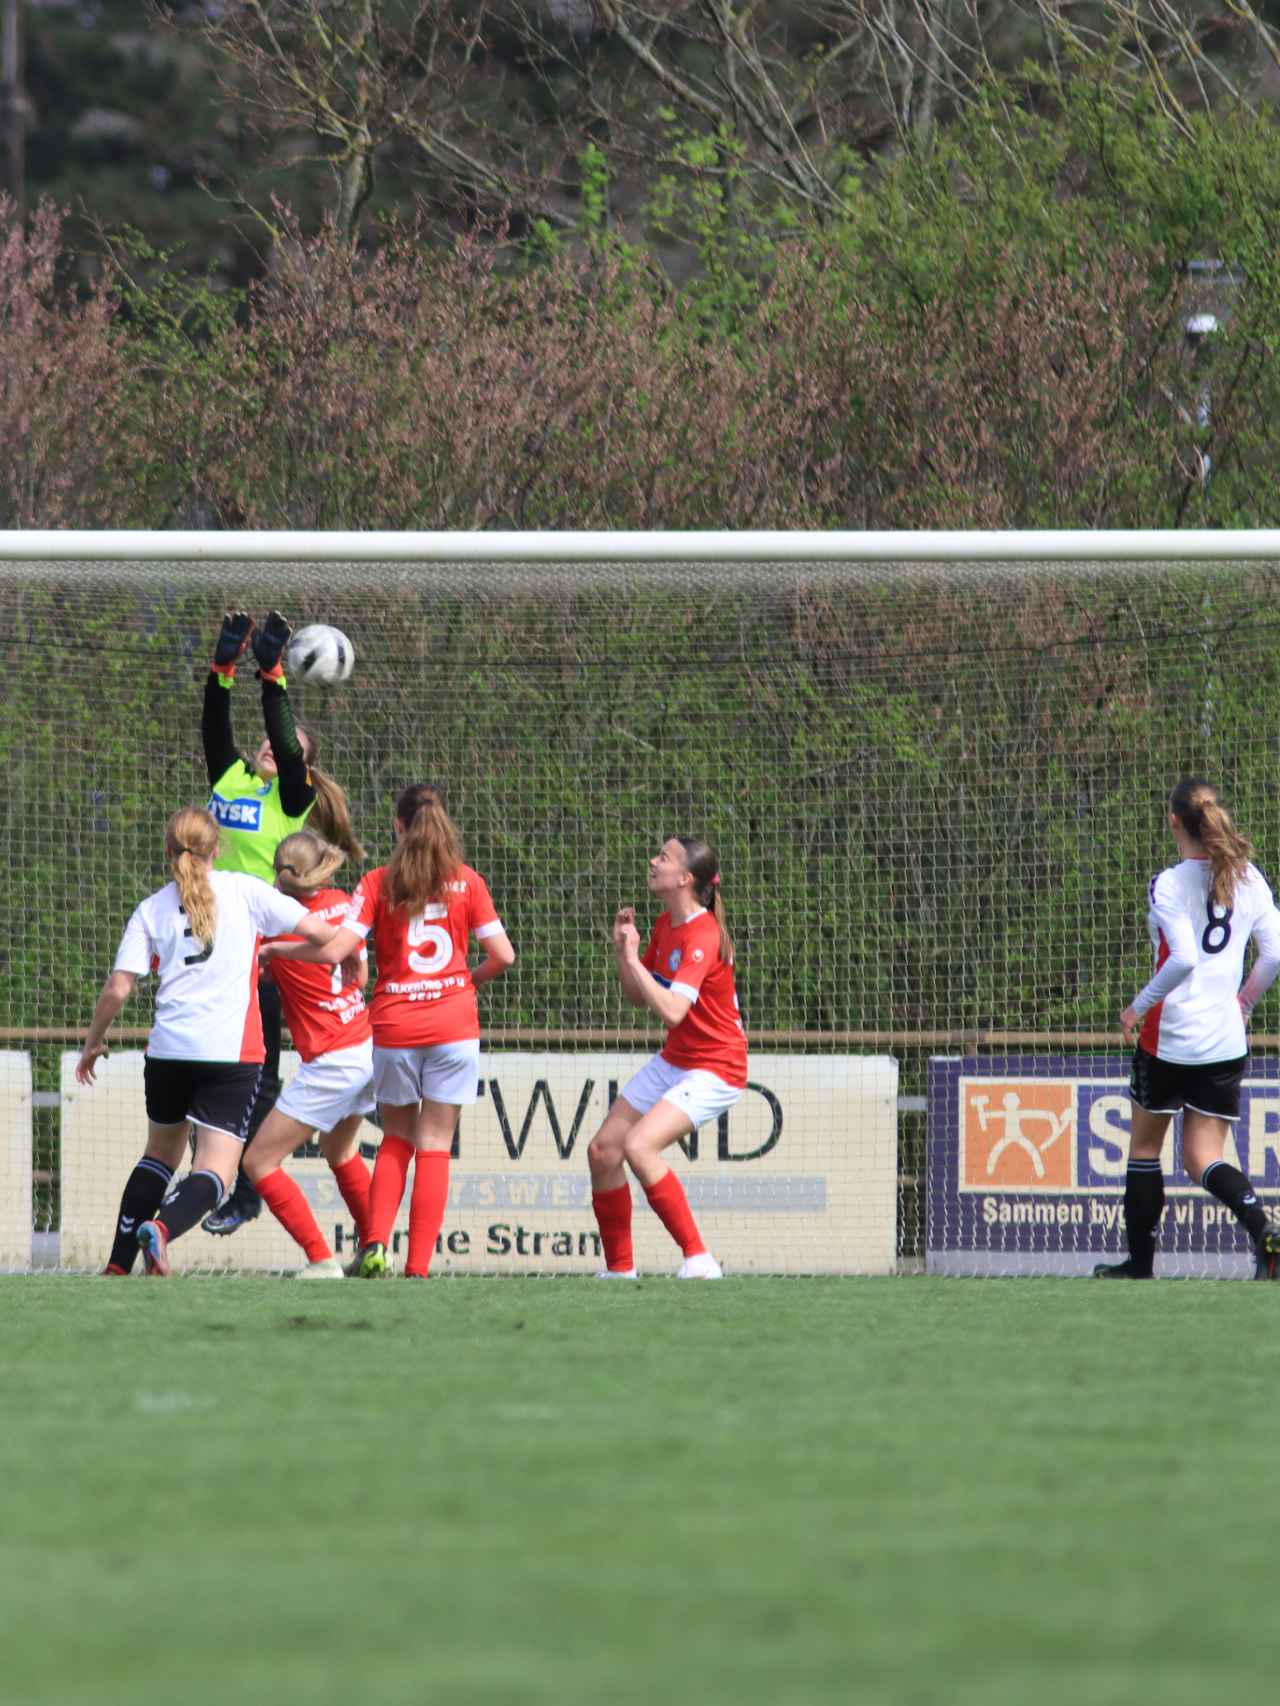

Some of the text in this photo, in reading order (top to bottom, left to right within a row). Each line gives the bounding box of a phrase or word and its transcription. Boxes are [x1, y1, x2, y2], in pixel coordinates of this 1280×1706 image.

[408, 902, 454, 975] 5
[1202, 889, 1233, 954] 8
[983, 1197, 1083, 1224] Sammen
[1175, 1199, 1194, 1224] vi
[487, 1223, 602, 1256] Stran
